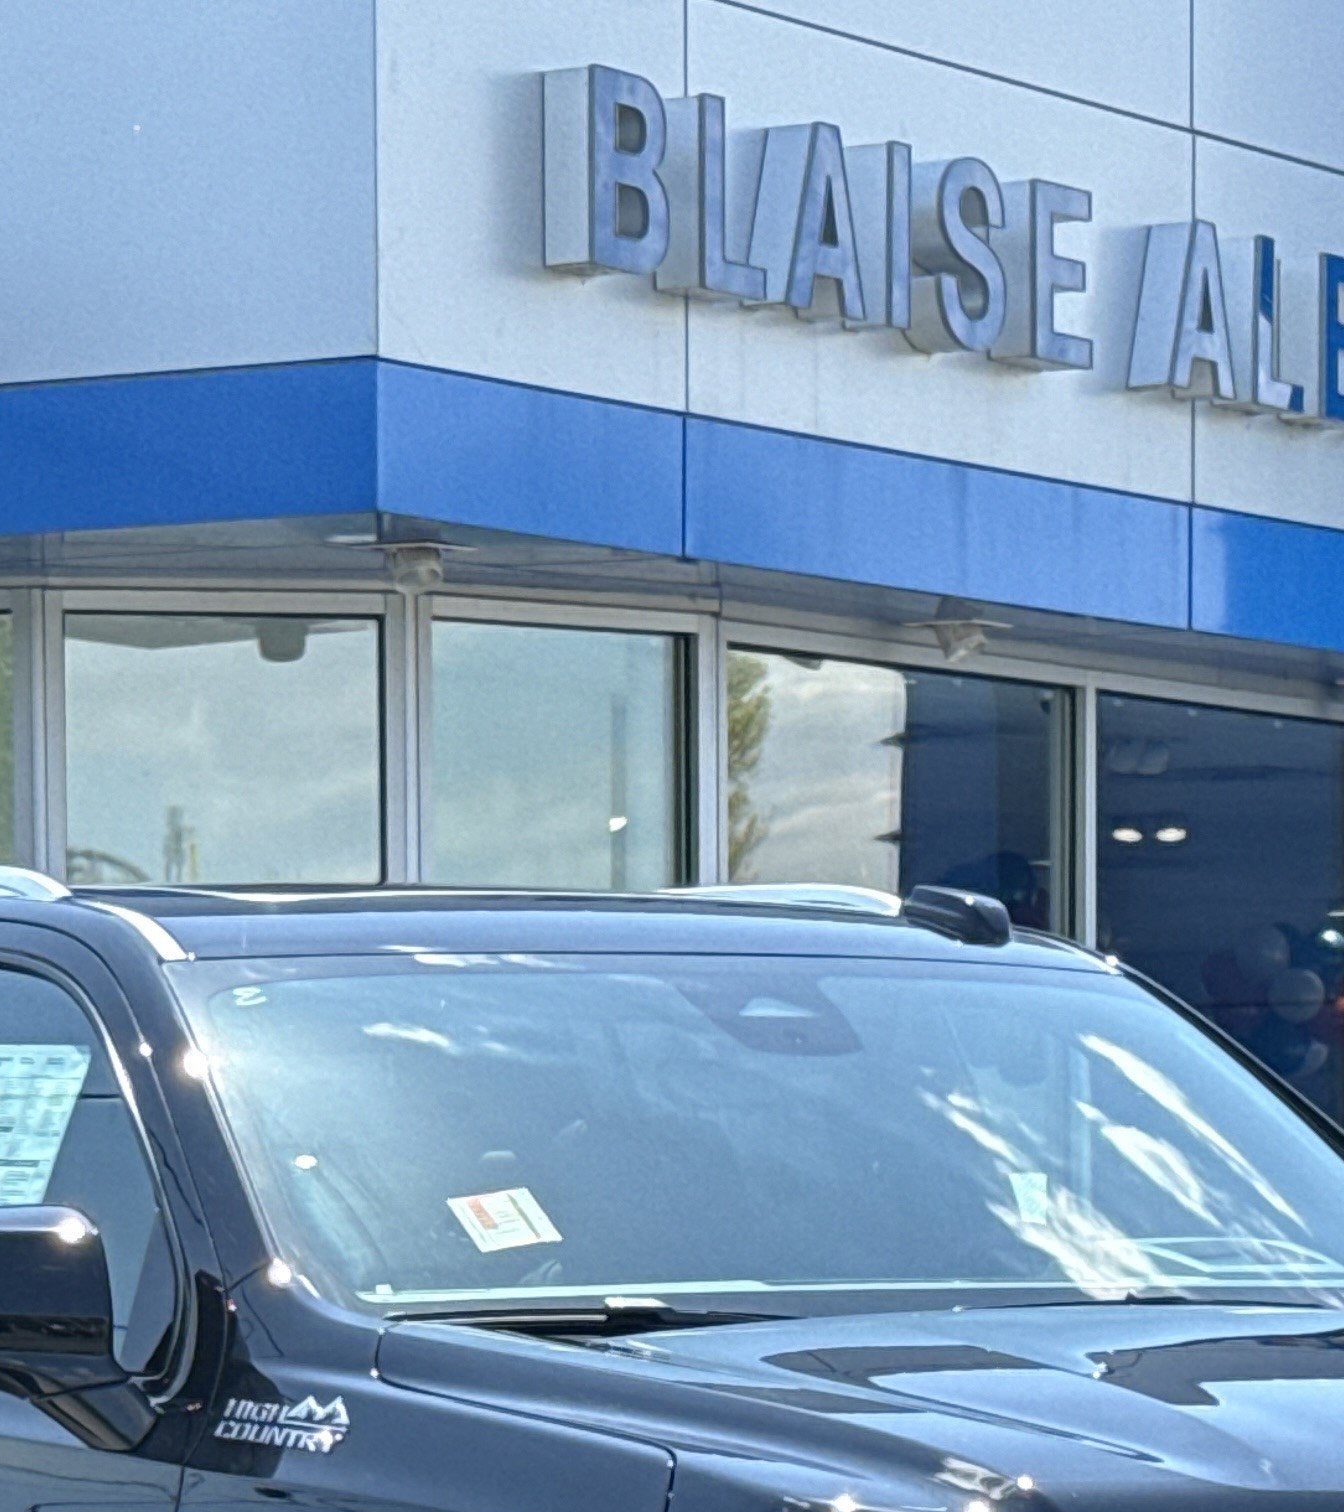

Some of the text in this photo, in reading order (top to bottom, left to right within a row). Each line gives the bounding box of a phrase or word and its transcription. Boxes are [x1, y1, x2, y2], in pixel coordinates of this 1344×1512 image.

[576, 62, 1093, 372] BLAISE
[223, 1396, 290, 1424] HIGH
[213, 1419, 333, 1453] COUNTRY
